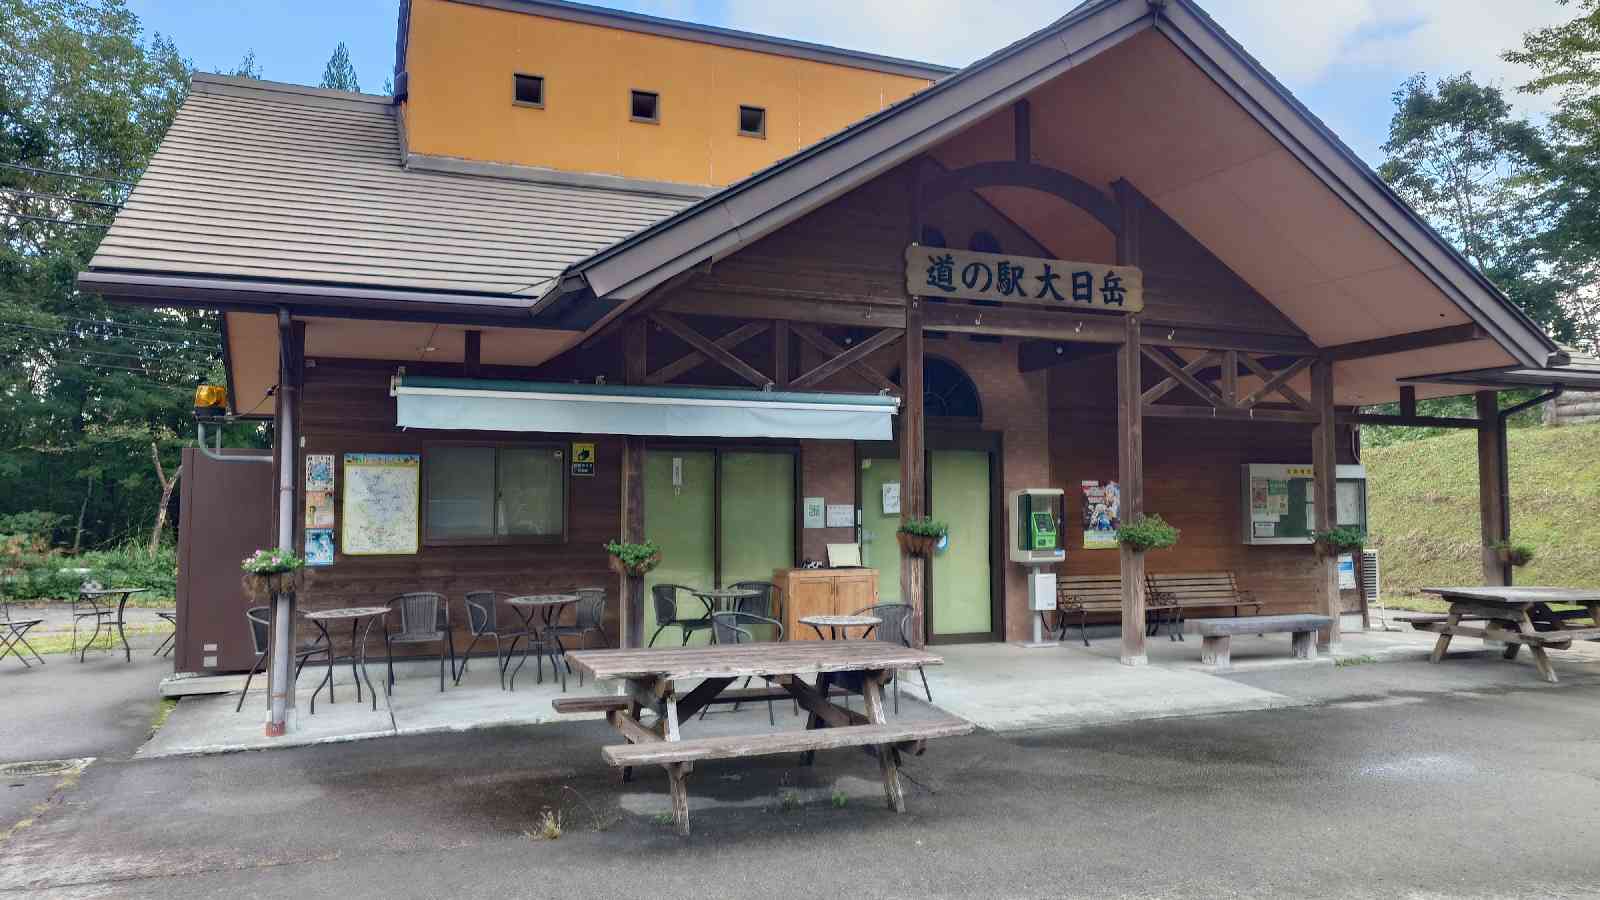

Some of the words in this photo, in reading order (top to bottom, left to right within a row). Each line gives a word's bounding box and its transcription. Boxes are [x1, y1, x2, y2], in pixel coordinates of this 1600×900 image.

[926, 253, 1127, 306] 道の駅大日岳
